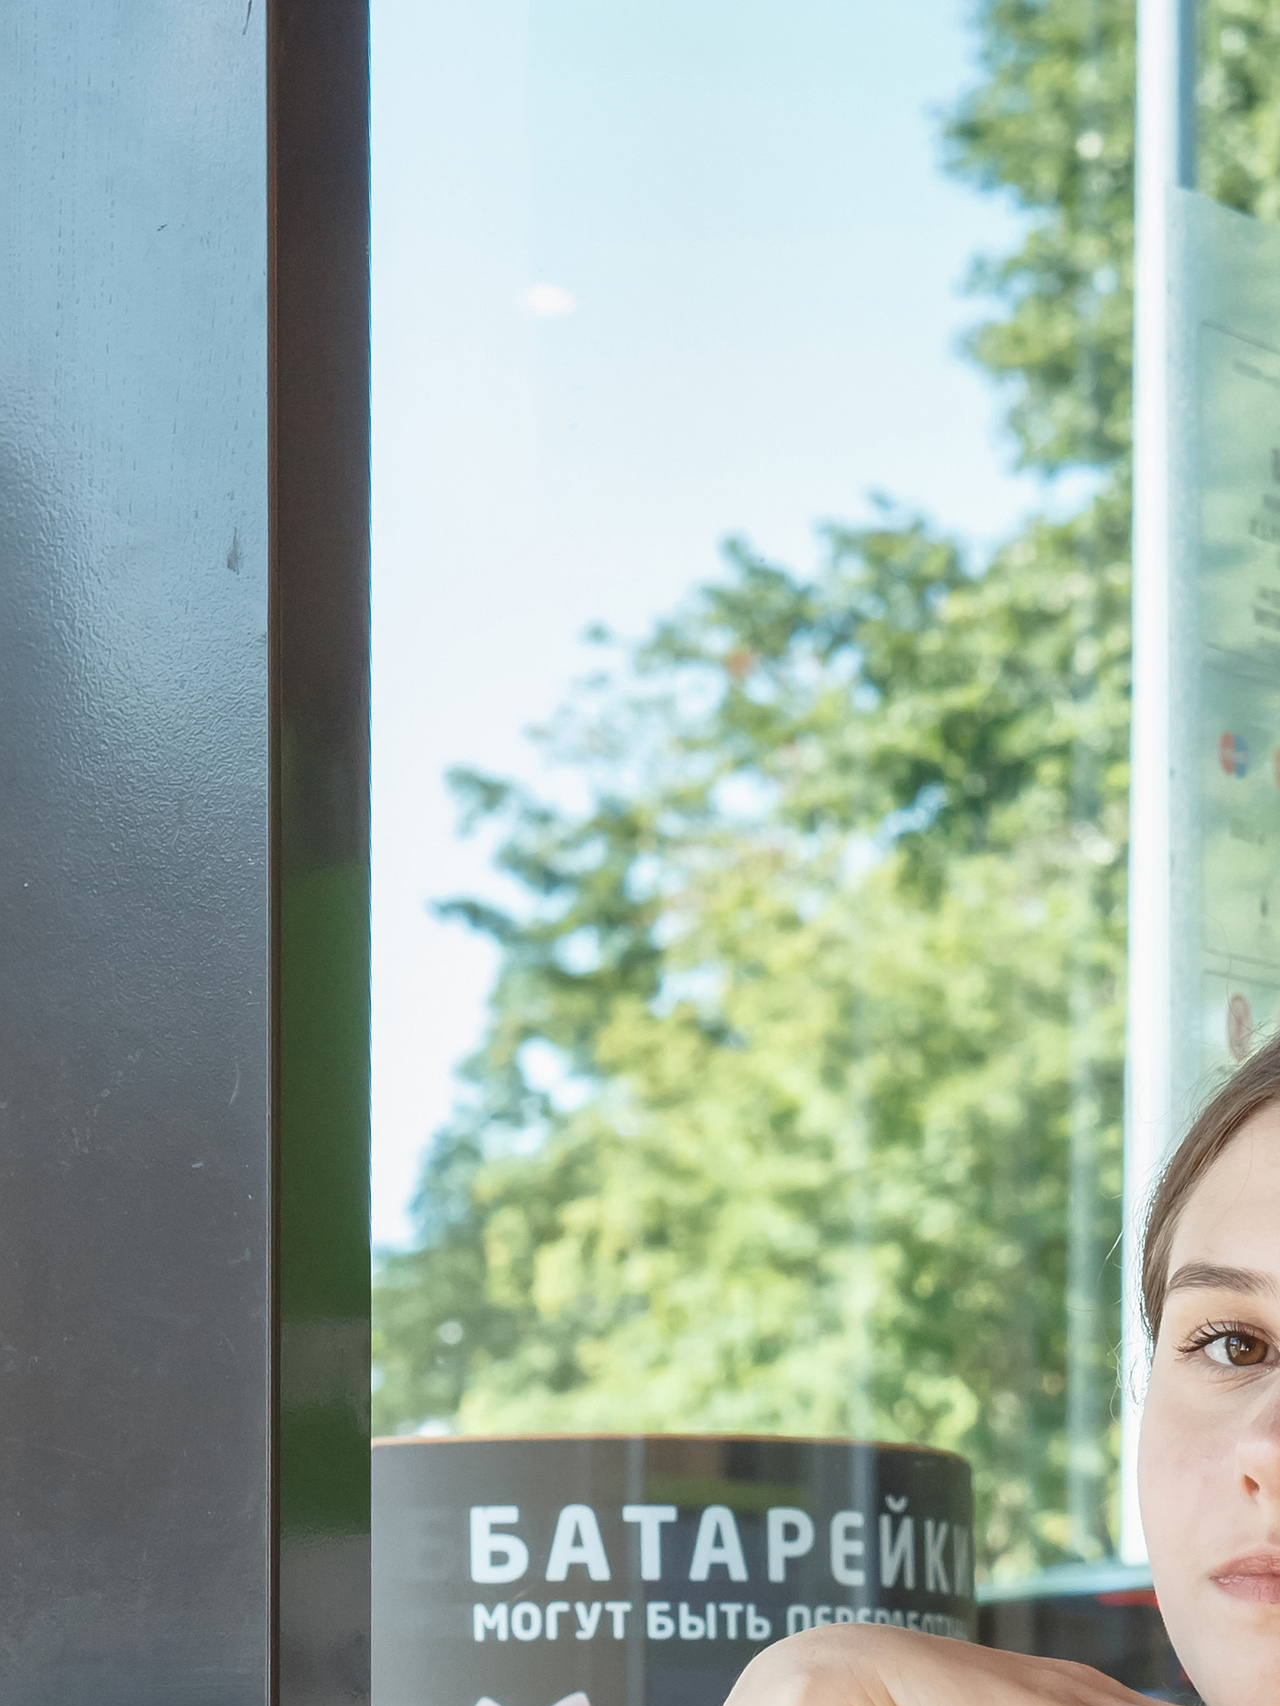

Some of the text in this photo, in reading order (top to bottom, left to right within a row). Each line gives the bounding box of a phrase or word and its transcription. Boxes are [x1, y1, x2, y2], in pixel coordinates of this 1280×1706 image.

[470, 1494, 973, 1598] БАТАРЕЙКИ
[472, 1601, 632, 1642] МОГУТ
[647, 1602, 772, 1640] БЫТЬ
